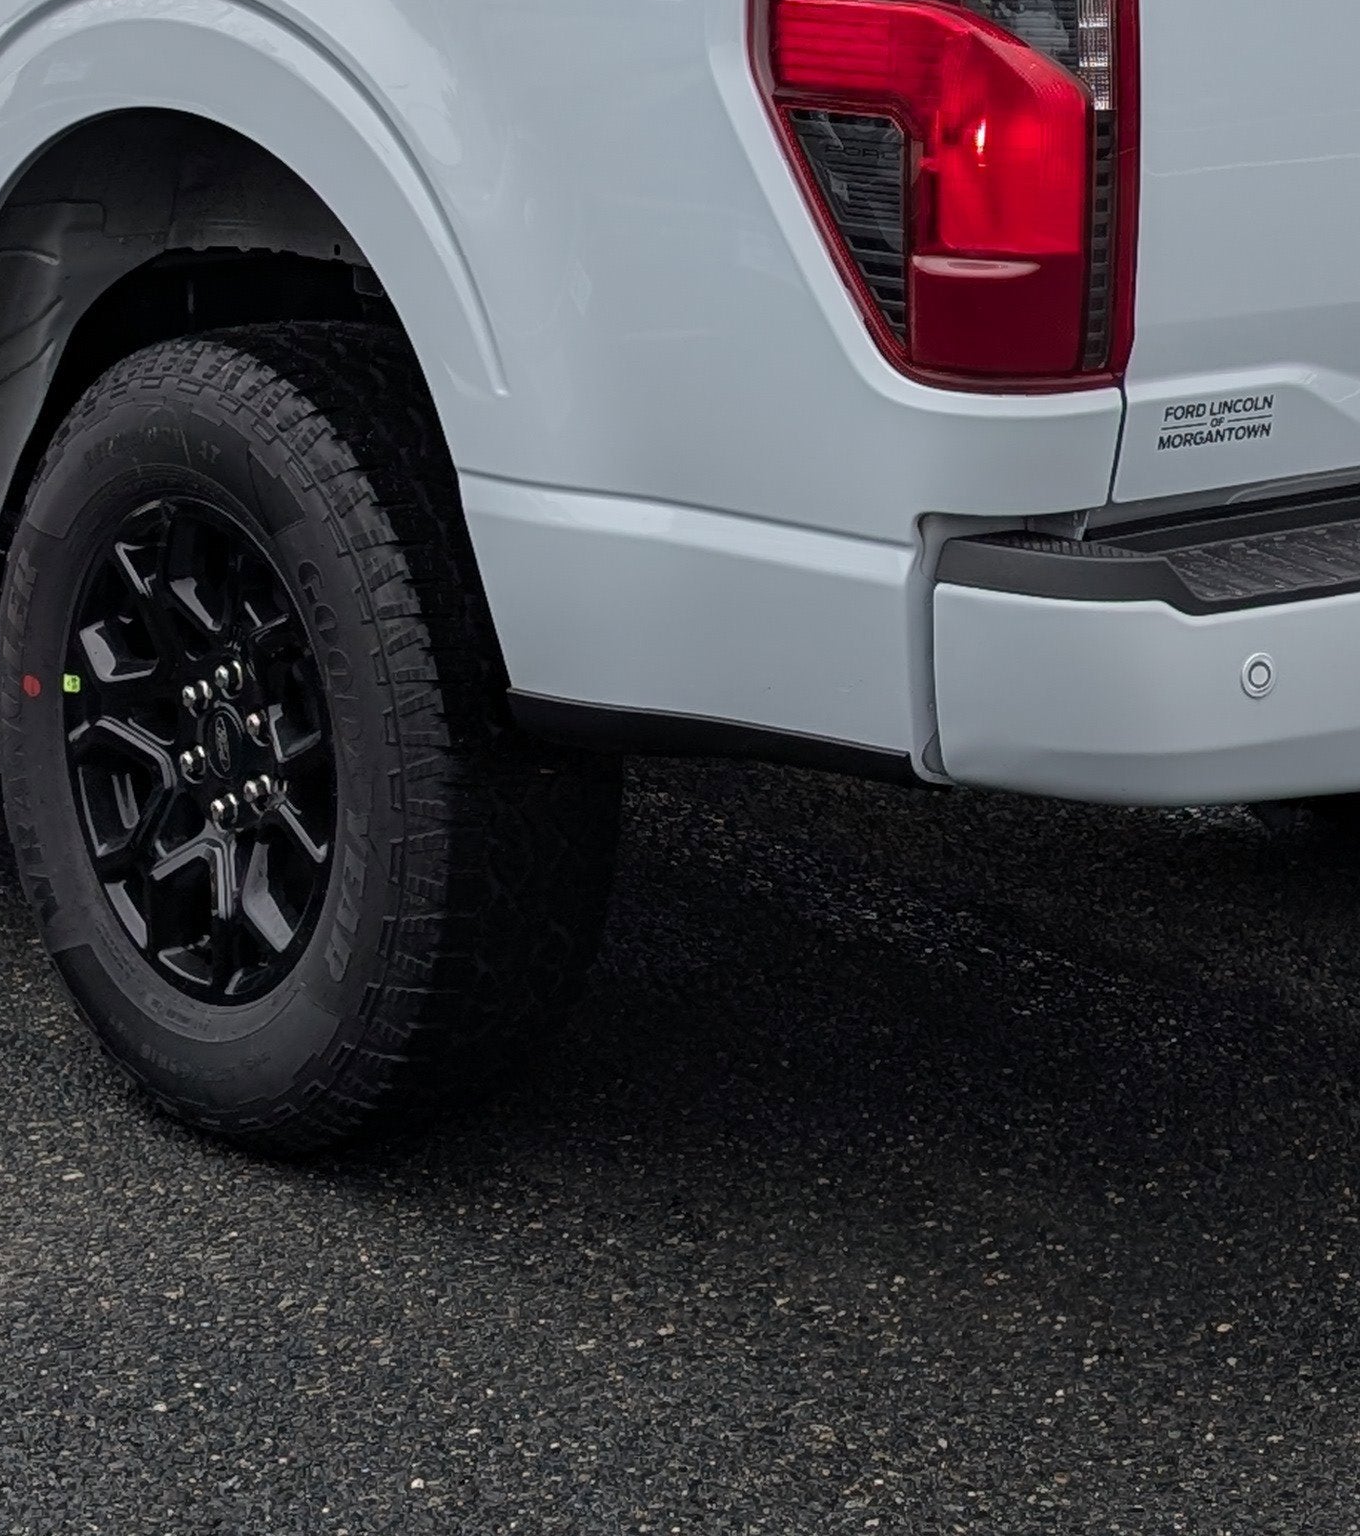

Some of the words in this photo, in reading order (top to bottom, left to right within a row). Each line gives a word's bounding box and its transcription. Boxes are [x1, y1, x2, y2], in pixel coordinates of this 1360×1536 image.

[1164, 403, 1206, 422] FORD
[1209, 394, 1274, 416] LINCOLN
[1157, 422, 1272, 450] MORGANTOWN
[1210, 417, 1225, 428] OF
